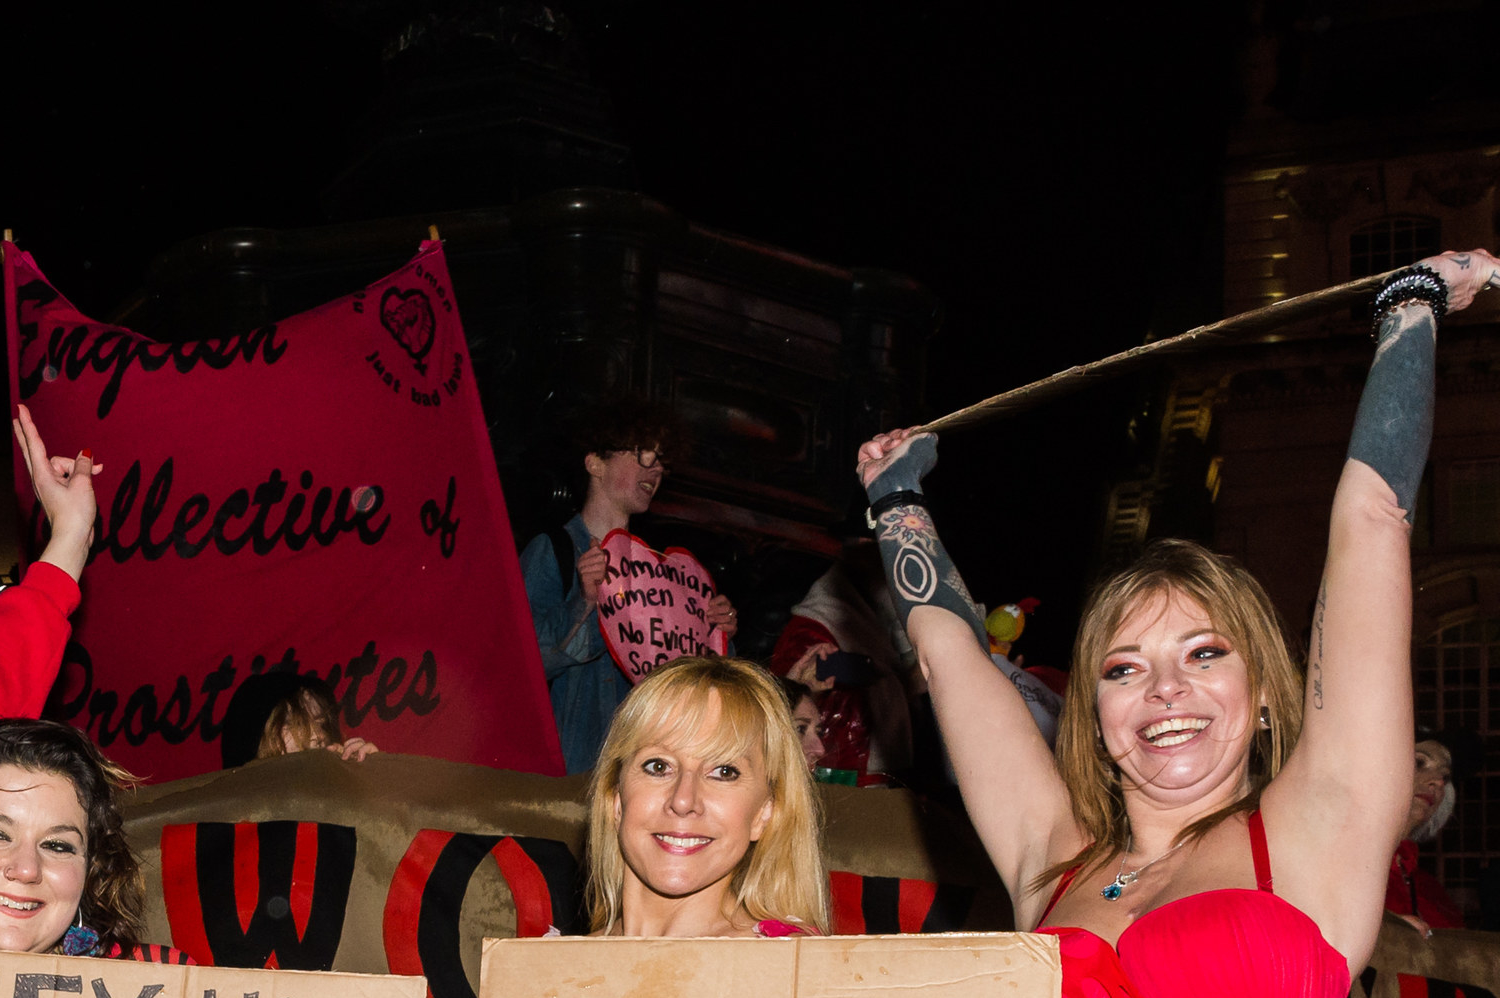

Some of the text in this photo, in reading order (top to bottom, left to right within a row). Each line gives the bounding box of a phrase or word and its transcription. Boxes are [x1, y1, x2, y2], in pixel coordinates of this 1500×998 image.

[415, 264, 453, 313] omen
[27, 456, 460, 566] llective of
[600, 586, 674, 620] women
[618, 621, 644, 645] No
[628, 651, 669, 676] Saf
